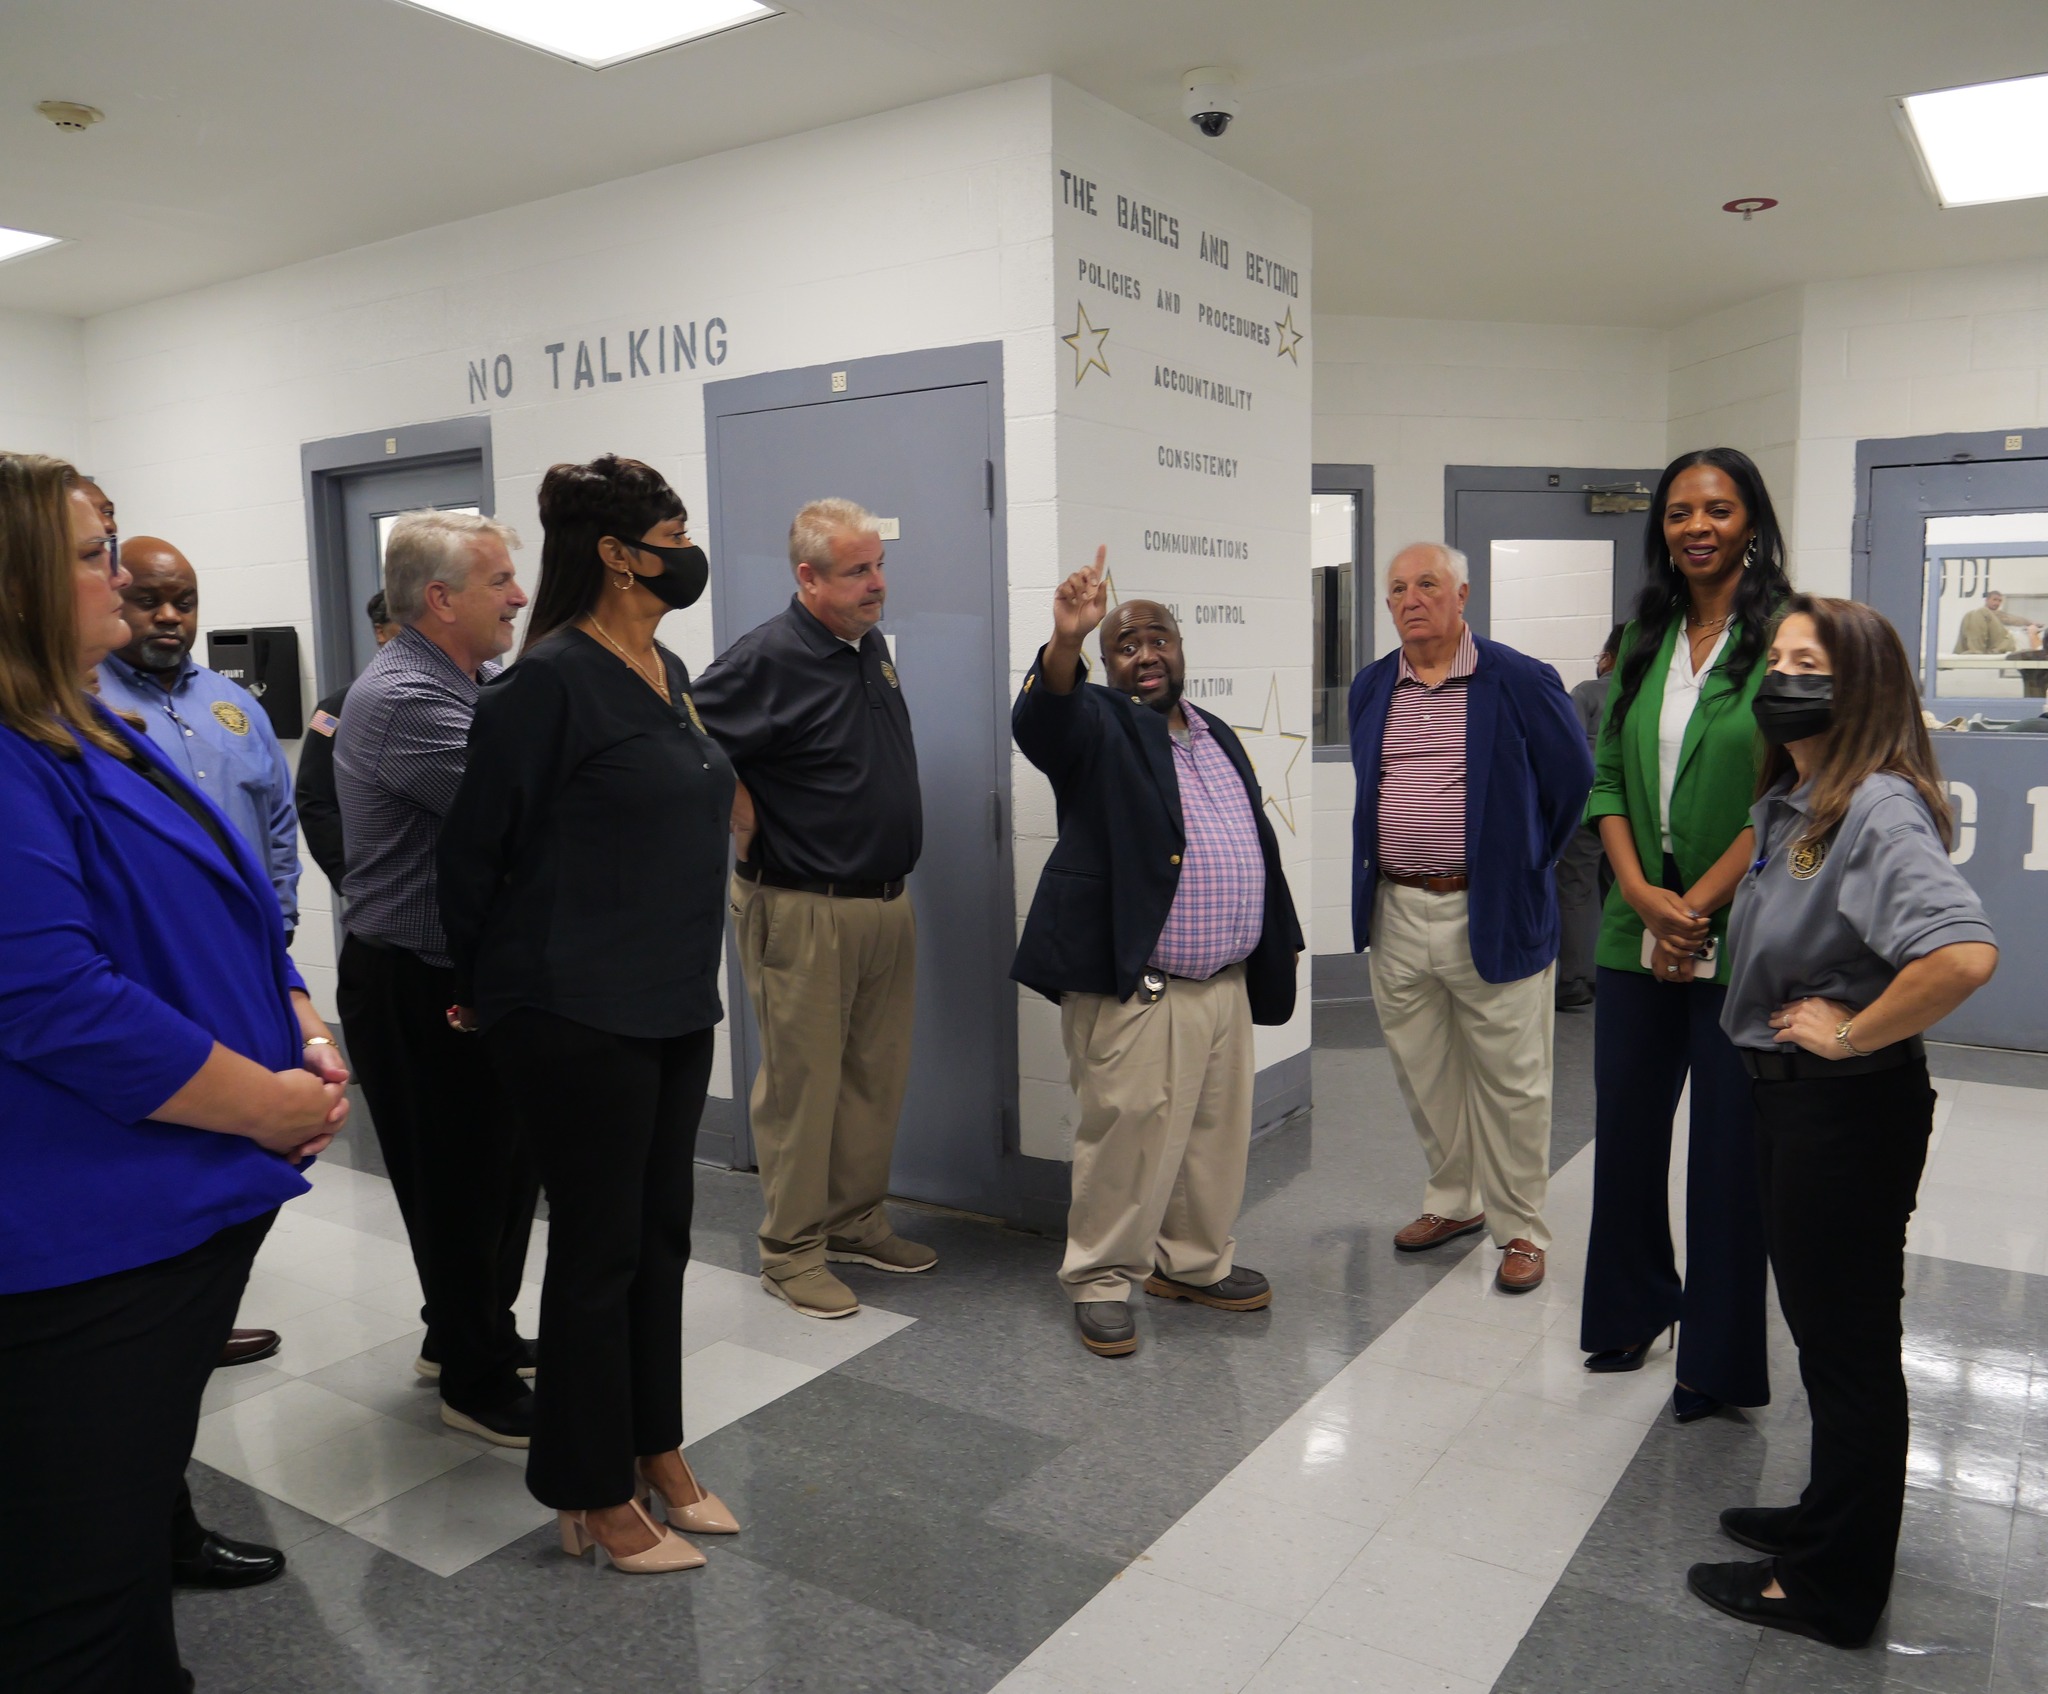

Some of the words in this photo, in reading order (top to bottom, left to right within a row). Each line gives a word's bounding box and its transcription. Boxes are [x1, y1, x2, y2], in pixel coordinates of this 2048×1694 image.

[1060, 169, 1097, 216] THE
[1117, 194, 1179, 250] BASICS
[1200, 231, 1229, 270] AND
[1246, 251, 1298, 299] BEYOND
[1079, 258, 1141, 300] POLICIES
[1157, 288, 1181, 314] AND
[1199, 303, 1271, 346] PROCEDURES
[468, 353, 513, 404] NO
[544, 316, 728, 391] TALKING
[1154, 365, 1253, 411] ACCOUNTABILITY
[1158, 445, 1239, 478] CONSISTENCY
[1144, 530, 1249, 560] COMMUNICATIONS
[1195, 605, 1246, 625] CONTROL
[1183, 678, 1234, 698] NITATION
